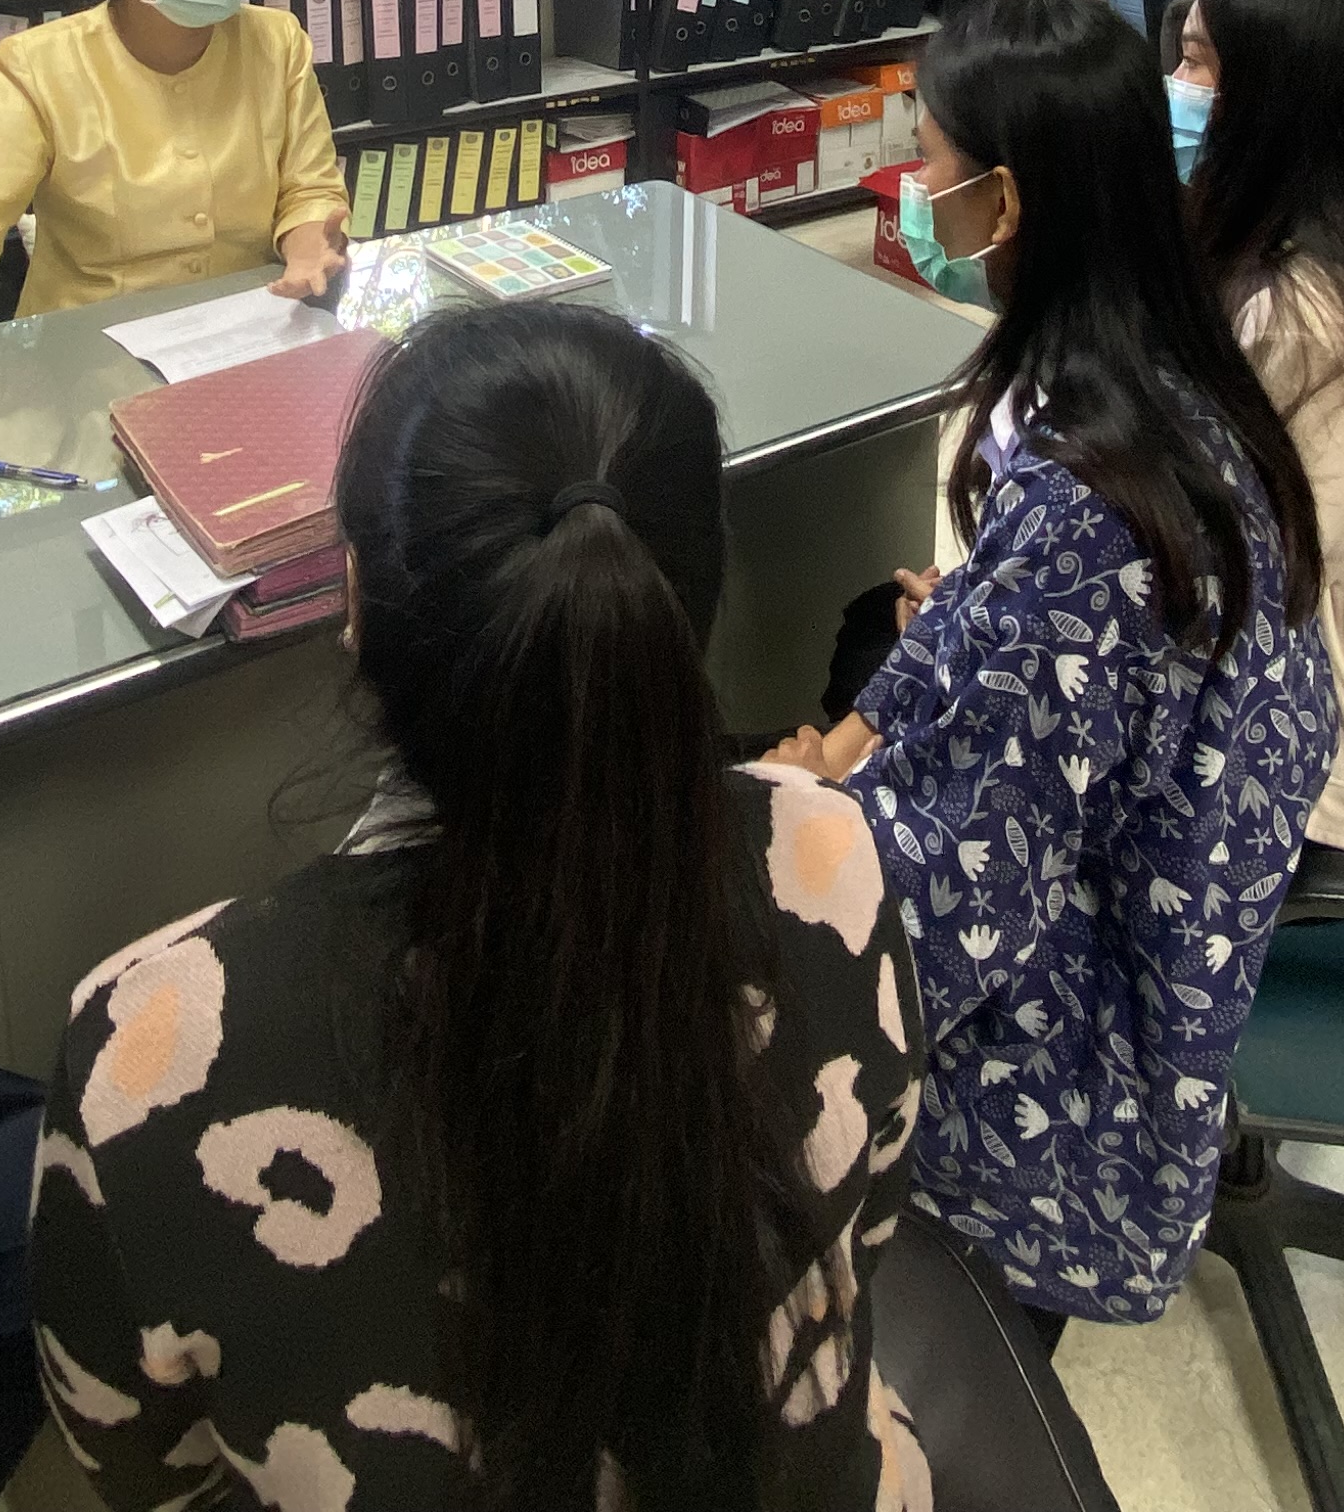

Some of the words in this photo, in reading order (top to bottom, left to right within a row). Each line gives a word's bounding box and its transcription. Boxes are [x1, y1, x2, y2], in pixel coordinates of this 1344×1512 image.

[837, 100, 871, 121] idea
[771, 118, 806, 135] idea
[570, 152, 611, 175] idea
[759, 169, 782, 183] dea
